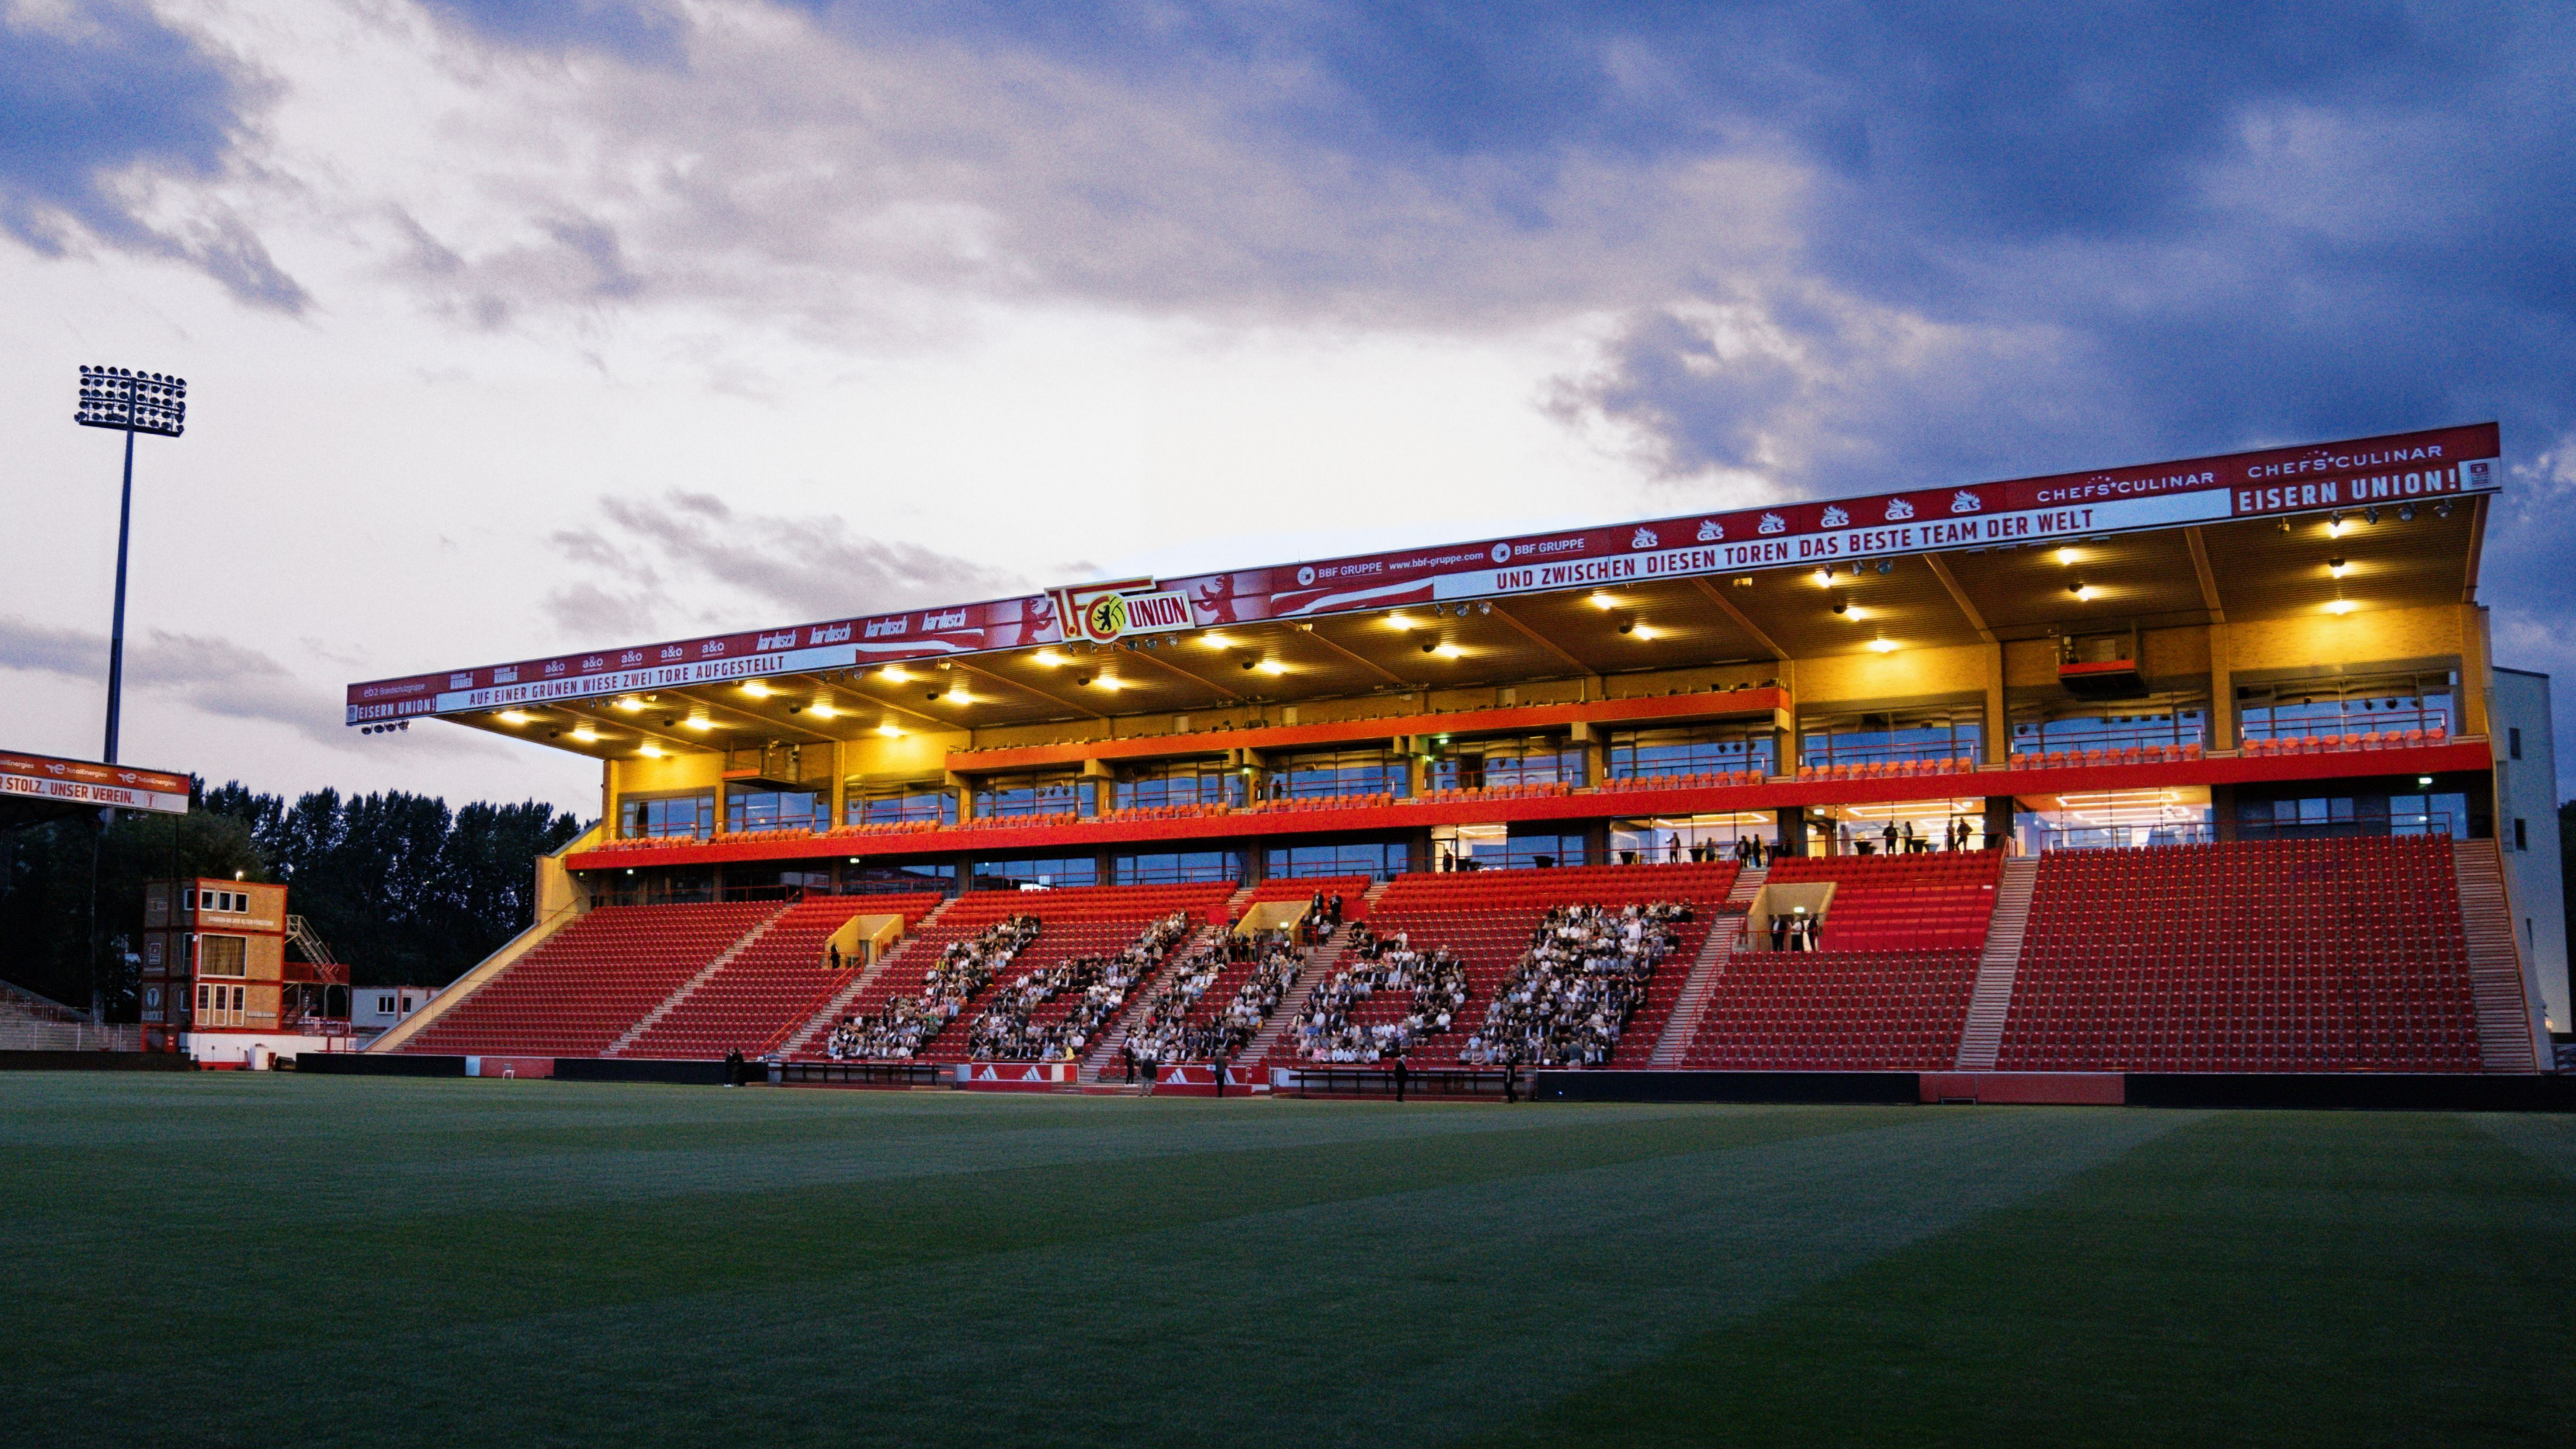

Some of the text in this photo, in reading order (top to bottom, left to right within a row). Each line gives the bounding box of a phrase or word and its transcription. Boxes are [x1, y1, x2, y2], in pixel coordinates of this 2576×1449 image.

[2248, 445, 2442, 478] CHEFS CULINAR
[2037, 472, 2214, 502] CHEFS CULINAR
[2239, 469, 2456, 511] EISERN UNION!
[1497, 509, 2093, 589] UND ZWISCHEN DIESEN TOREN DAS BESTE TEAM DER WELT
[1514, 538, 1584, 555] BBF GRUPPE
[1389, 553, 1484, 570] www.bbf-gruppe.com
[1318, 562, 1382, 578] BBF GRUPPE
[1127, 596, 1188, 628] UNION
[661, 645, 683, 658] a&o
[702, 640, 724, 653] a&o
[582, 656, 603, 668] a&o
[621, 651, 642, 663] a&o
[545, 661, 566, 673] a&o
[450, 678, 473, 689] KURIER
[470, 656, 784, 705] AUF EINER GRÜNEN WIESE ZWEI TORE AUFGESTELLT
[493, 671, 517, 684] KURIER
[359, 703, 394, 719] EISERN
[398, 698, 435, 715] UNION!
[67, 767, 107, 777] TotalEnergies
[138, 776, 176, 787] TotalEnergies
[6, 777, 45, 794] STOLZ.
[50, 782, 88, 798] UNSER
[93, 787, 135, 804] VEREIN.
